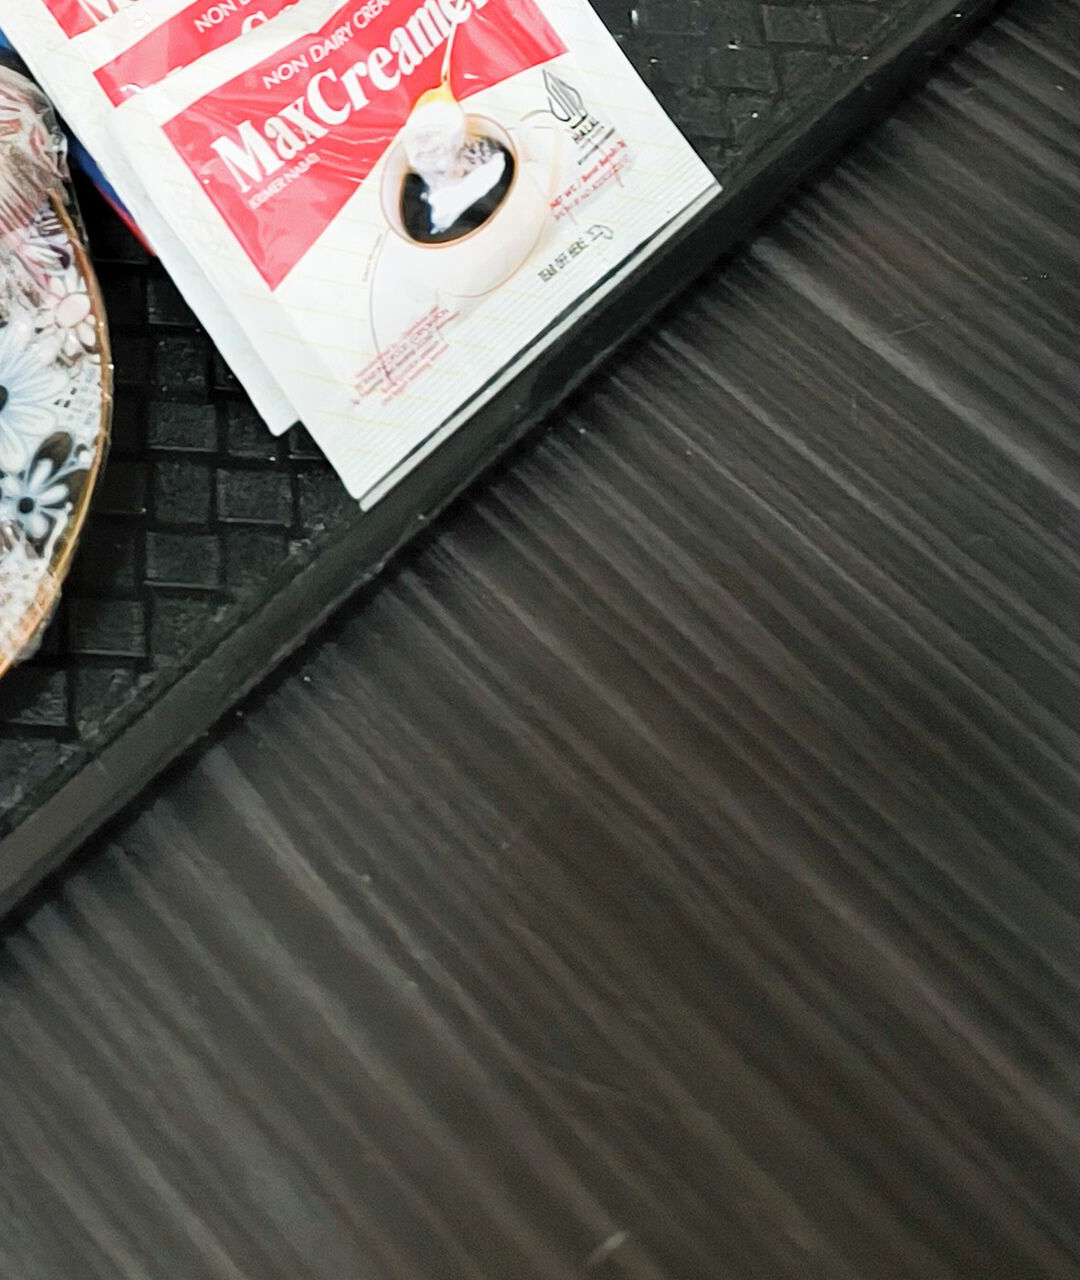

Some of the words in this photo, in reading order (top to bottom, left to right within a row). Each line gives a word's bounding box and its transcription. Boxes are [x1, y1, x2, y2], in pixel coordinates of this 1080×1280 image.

[194, 0, 233, 33] NON
[262, 55, 308, 89] NON
[310, 24, 354, 63] DAIRY
